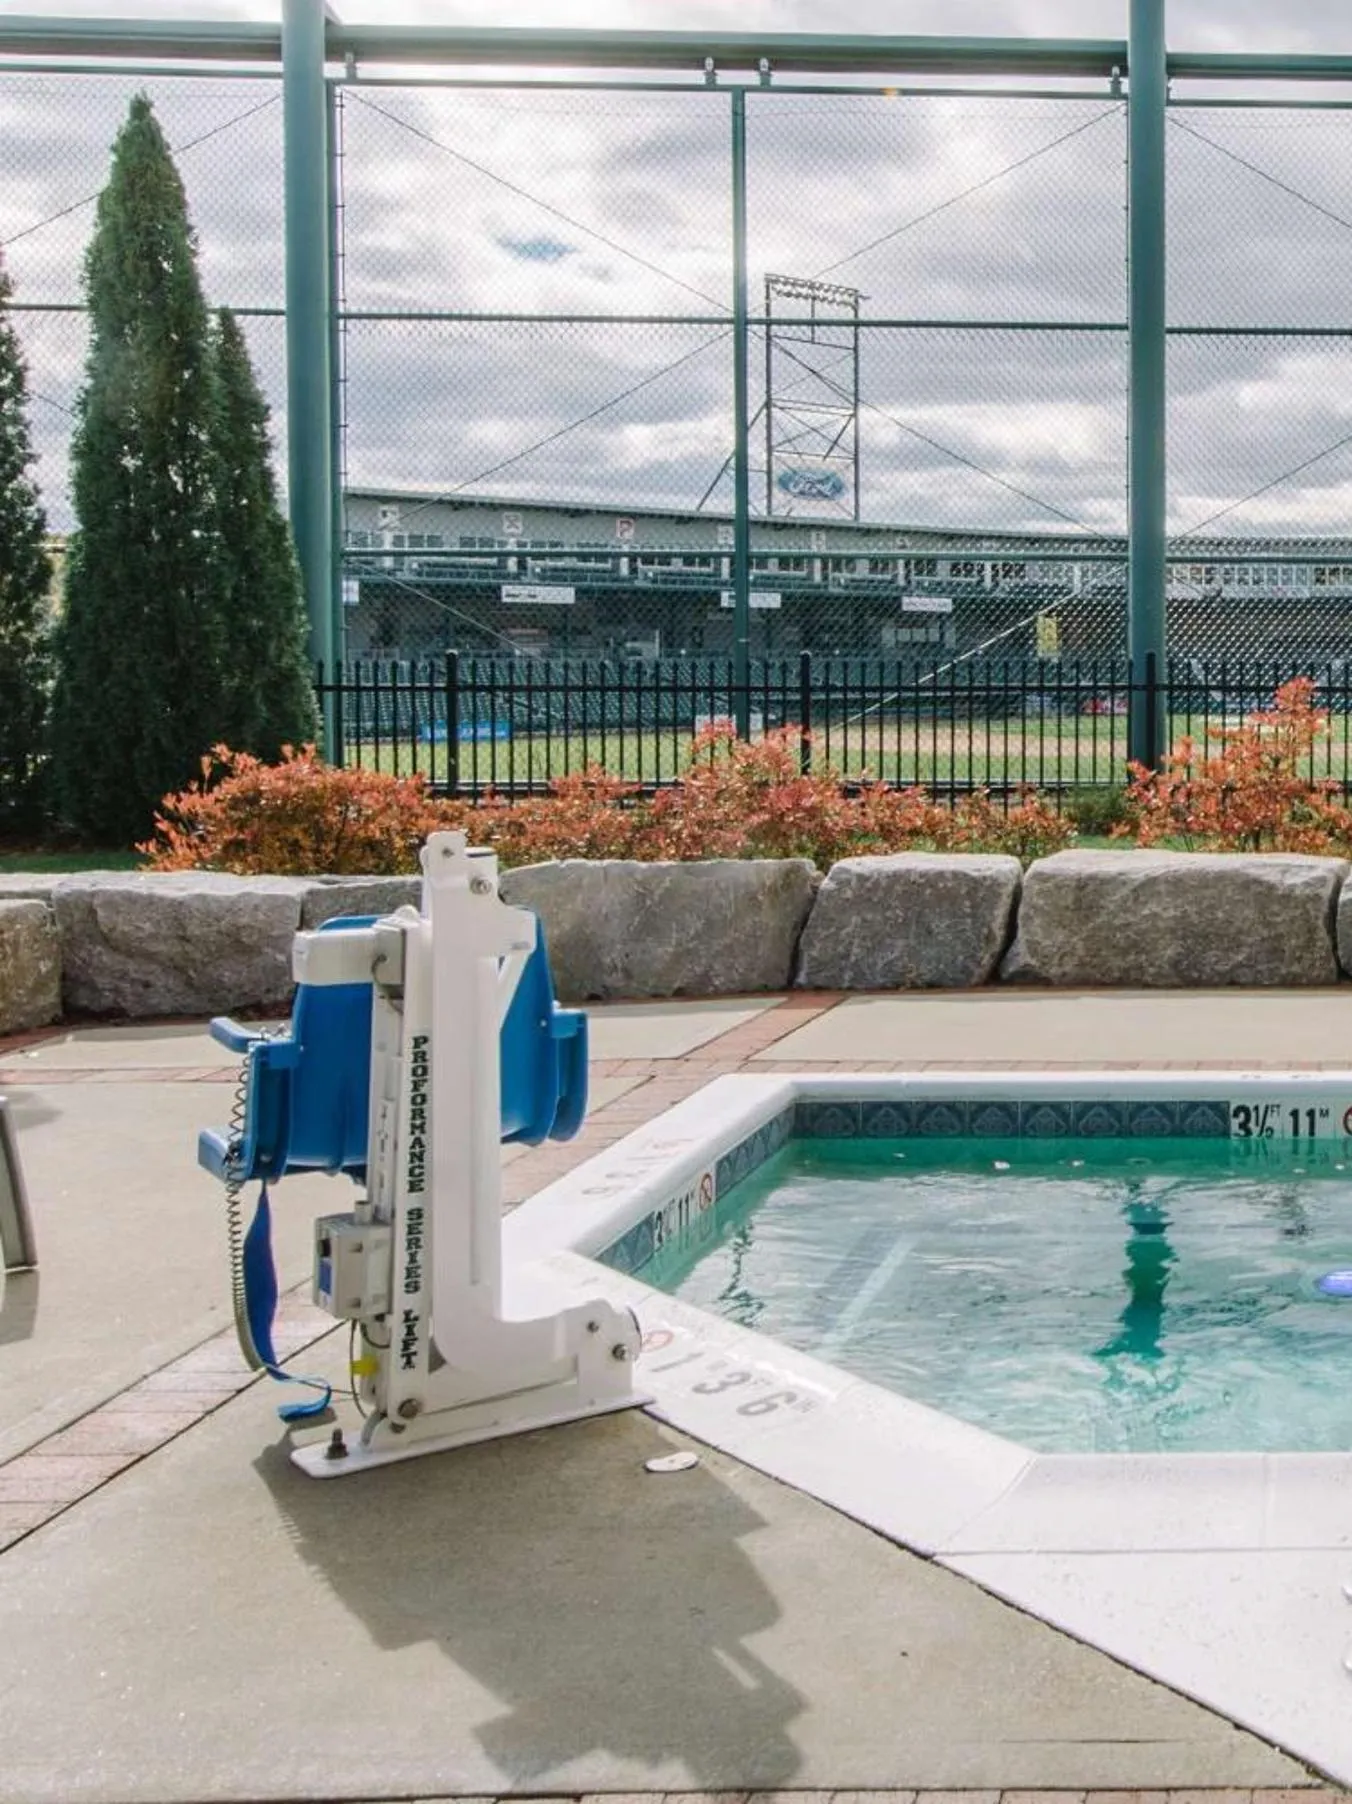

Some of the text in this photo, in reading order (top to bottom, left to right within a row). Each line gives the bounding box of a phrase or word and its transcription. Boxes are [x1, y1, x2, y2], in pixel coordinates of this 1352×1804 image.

[401, 1035, 429, 1370] PROFORMANCE SERIES LIFT
